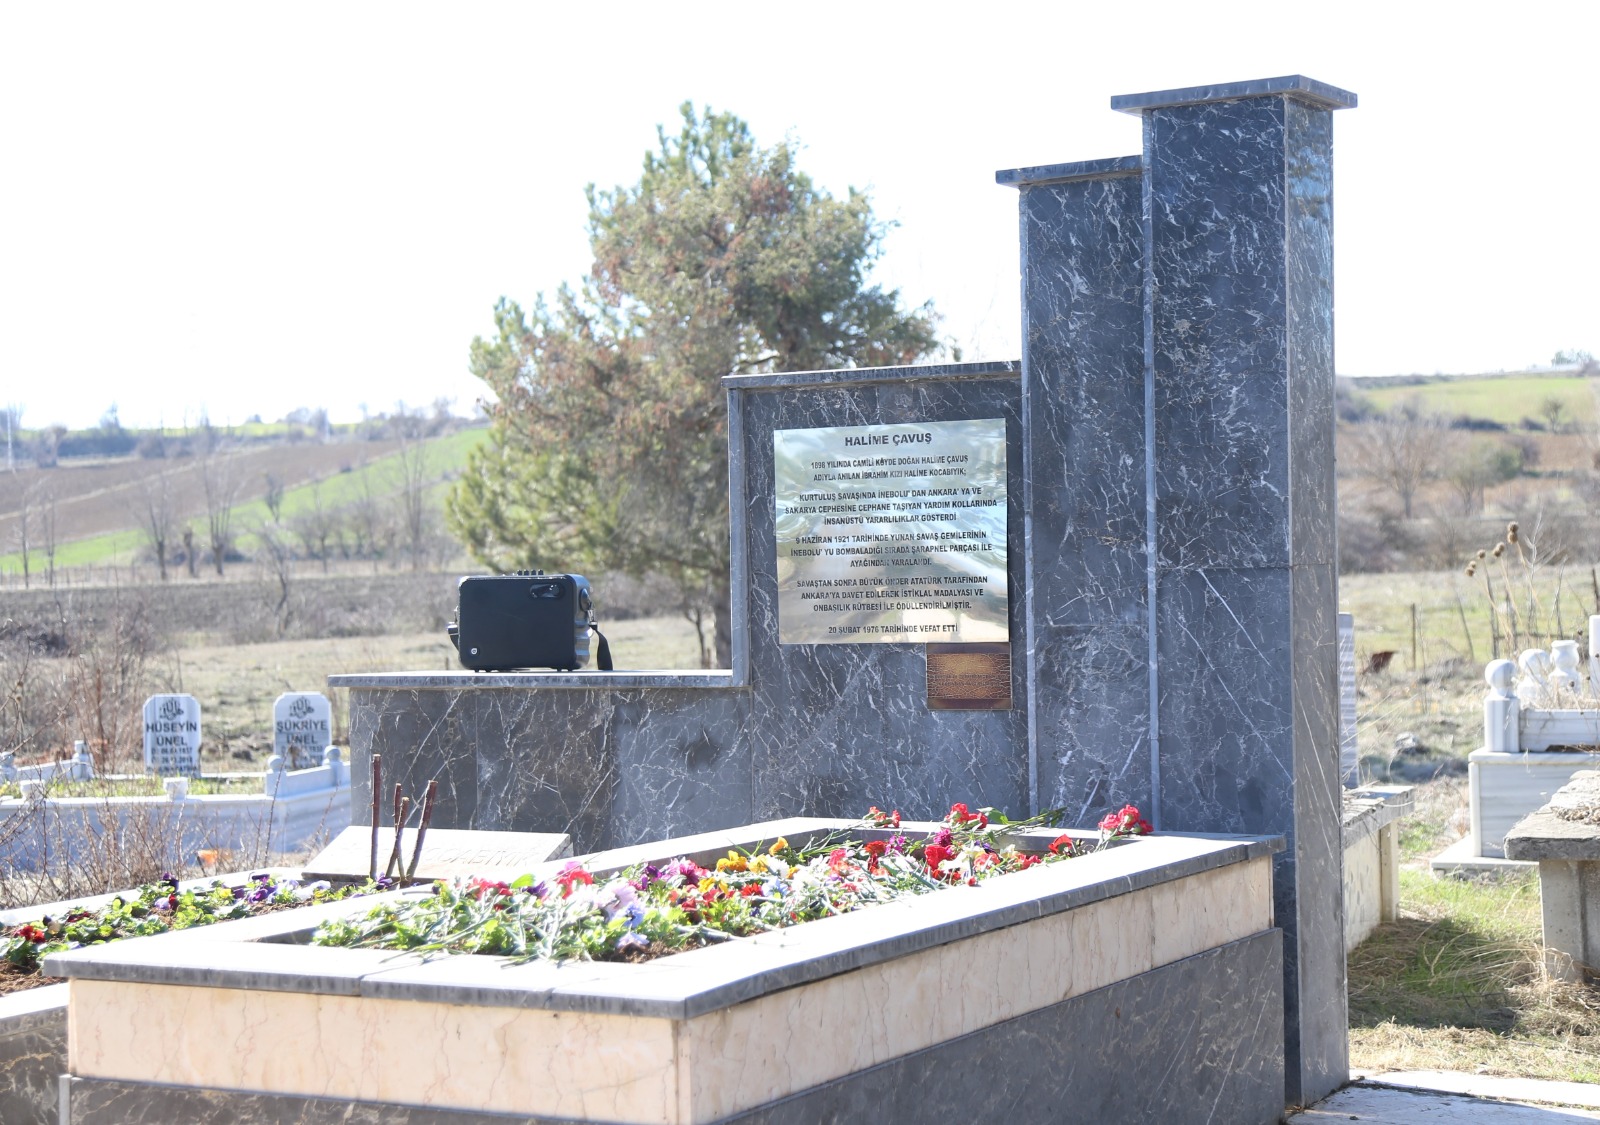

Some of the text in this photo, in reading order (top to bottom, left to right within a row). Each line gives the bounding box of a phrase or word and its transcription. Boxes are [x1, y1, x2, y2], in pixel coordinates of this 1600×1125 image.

[845, 432, 932, 446] HALİME ÇAVUŞ
[826, 460, 852, 469] YILINDA
[852, 457, 875, 468] CAMİLİ
[875, 457, 897, 466] KÖYDE
[897, 456, 920, 465] DOĞAN
[946, 454, 969, 464] ÇAVUŞ
[861, 470, 888, 480] İBRAHİM
[799, 493, 836, 502] KURTULUŞ
[837, 491, 876, 501] SAVAŞINDA
[911, 489, 926, 497] DAN
[960, 487, 970, 495] YA
[971, 487, 982, 495] VE
[785, 499, 998, 515] SAKARYA CEPHESİNE CEPHANE TAŞIYAN YARDIM KOLLARINDA
[824, 512, 957, 526] İNSANÜSTÜ YARARLILIKLAR GÖSTERDİ
[795, 529, 987, 545] 9 HAZİRAN 1921 TARİHİNDE YUNAN SAVAŞ GEMİLERİNİN
[824, 548, 834, 556] YU
[835, 545, 883, 556] BOMBALADIĞI
[884, 546, 910, 554] SIRADA
[911, 545, 948, 555] ŞARAPNEL
[949, 543, 980, 553] PARÇASI
[981, 542, 992, 552] İLE
[796, 579, 832, 589] SAVAŞTAN
[833, 578, 858, 587] SONRA
[859, 576, 883, 586] BÜYÜK
[910, 575, 942, 585] ATATÜRK
[944, 575, 988, 584] TARAFINDAN
[801, 591, 841, 600] ANKARA'YA
[842, 590, 864, 599] DAVET
[901, 588, 932, 598] İSTİKLAL
[933, 588, 973, 597] MADALYASI
[974, 588, 984, 596] VE
[813, 604, 850, 613] ONBAŞILIK
[852, 601, 882, 611] RÜTBESİ
[883, 601, 895, 610] İLE
[828, 622, 958, 635] 20 ŞUBAT 1976 TARİHİNDE VEFAT ETTİ
[146, 720, 197, 733] HÜSEYİN
[276, 718, 328, 733] ŞÜKRİYE
[156, 735, 186, 746] ÜNEL
